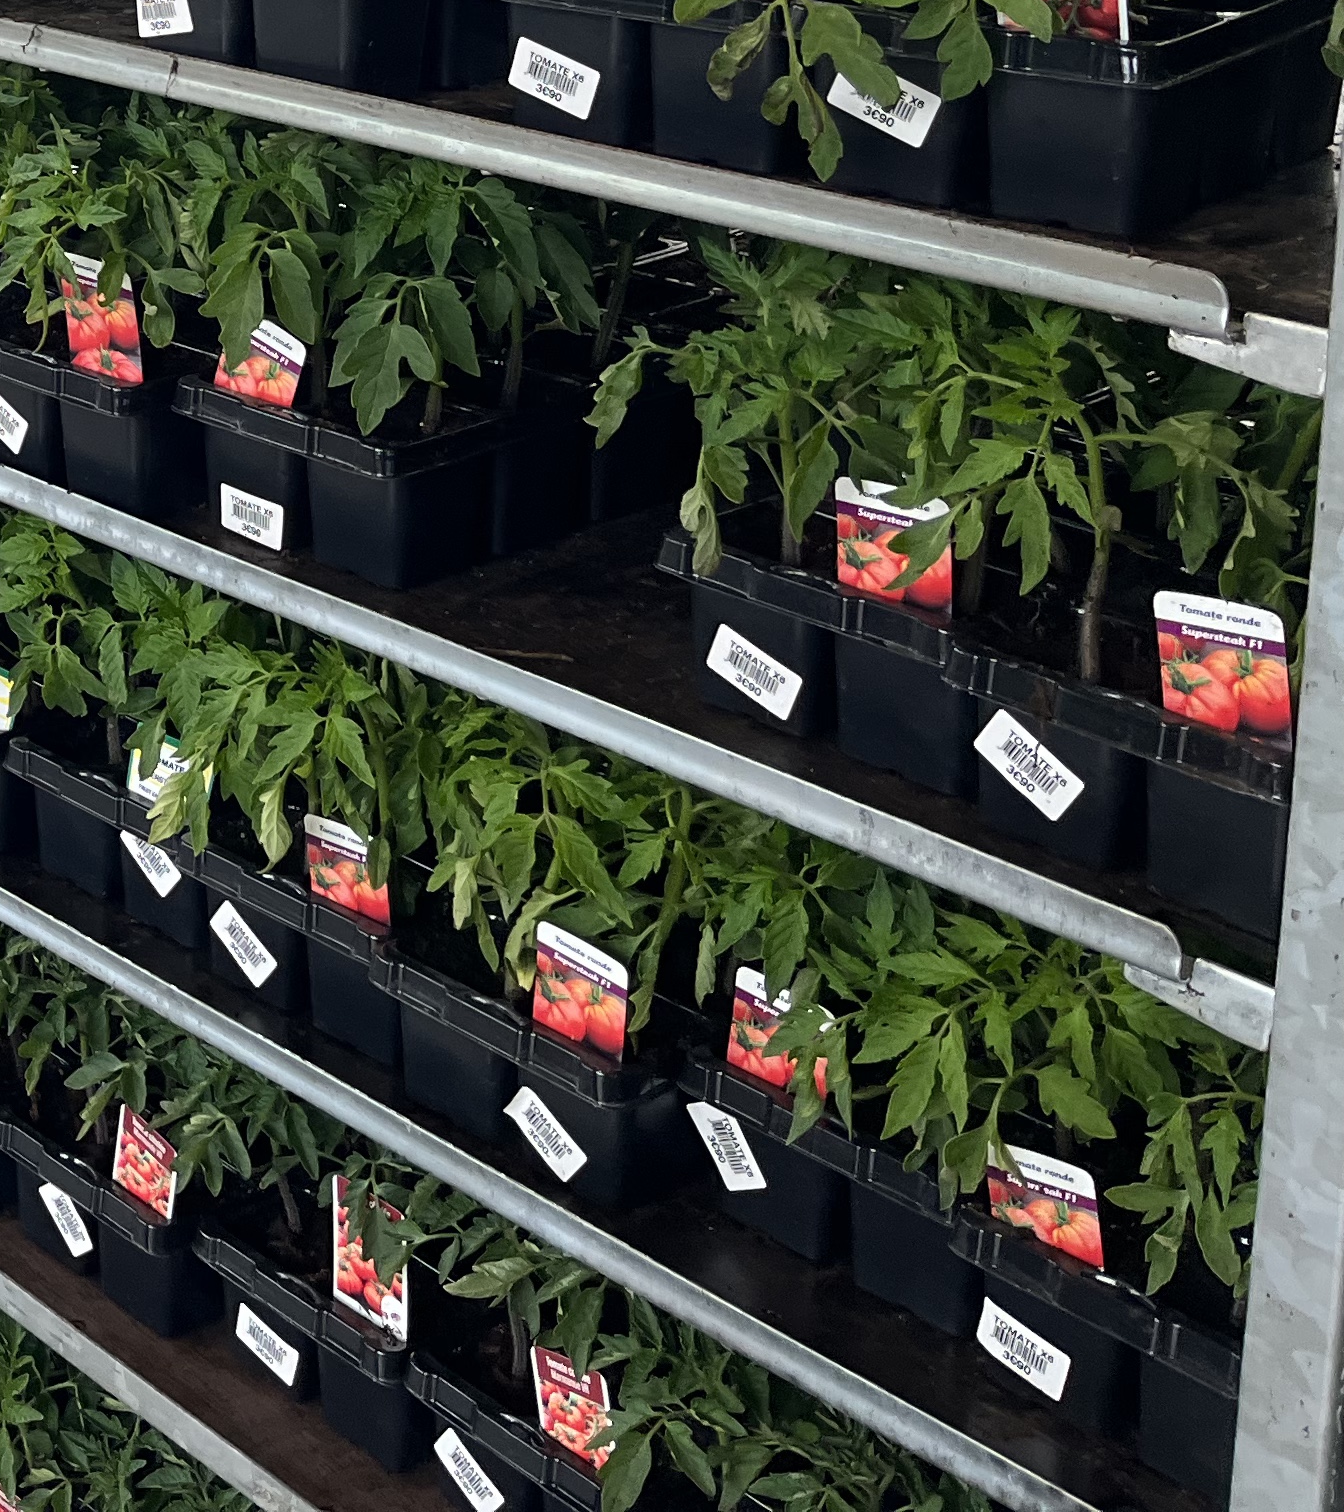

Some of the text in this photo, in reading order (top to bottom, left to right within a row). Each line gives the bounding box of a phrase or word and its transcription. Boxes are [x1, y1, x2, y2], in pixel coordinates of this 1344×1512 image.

[530, 51, 571, 76] TOMATE
[230, 494, 263, 512] TOMATE
[1179, 603, 1262, 628] Tomate ronde
[1181, 624, 1263, 651] Supersteak F1
[730, 640, 772, 673] TOMATE
[1008, 729, 1053, 773] TOMATE
[231, 916, 259, 952] TOMATE
[553, 951, 600, 984] Supersteak
[555, 935, 613, 973] Tomate ronde
[529, 1100, 563, 1142] TOMATE
[720, 1116, 747, 1162] TOMATE
[1044, 1167, 1075, 1184] ronde
[1063, 1192, 1077, 1204] F1
[994, 1314, 1038, 1351] TOMATE
